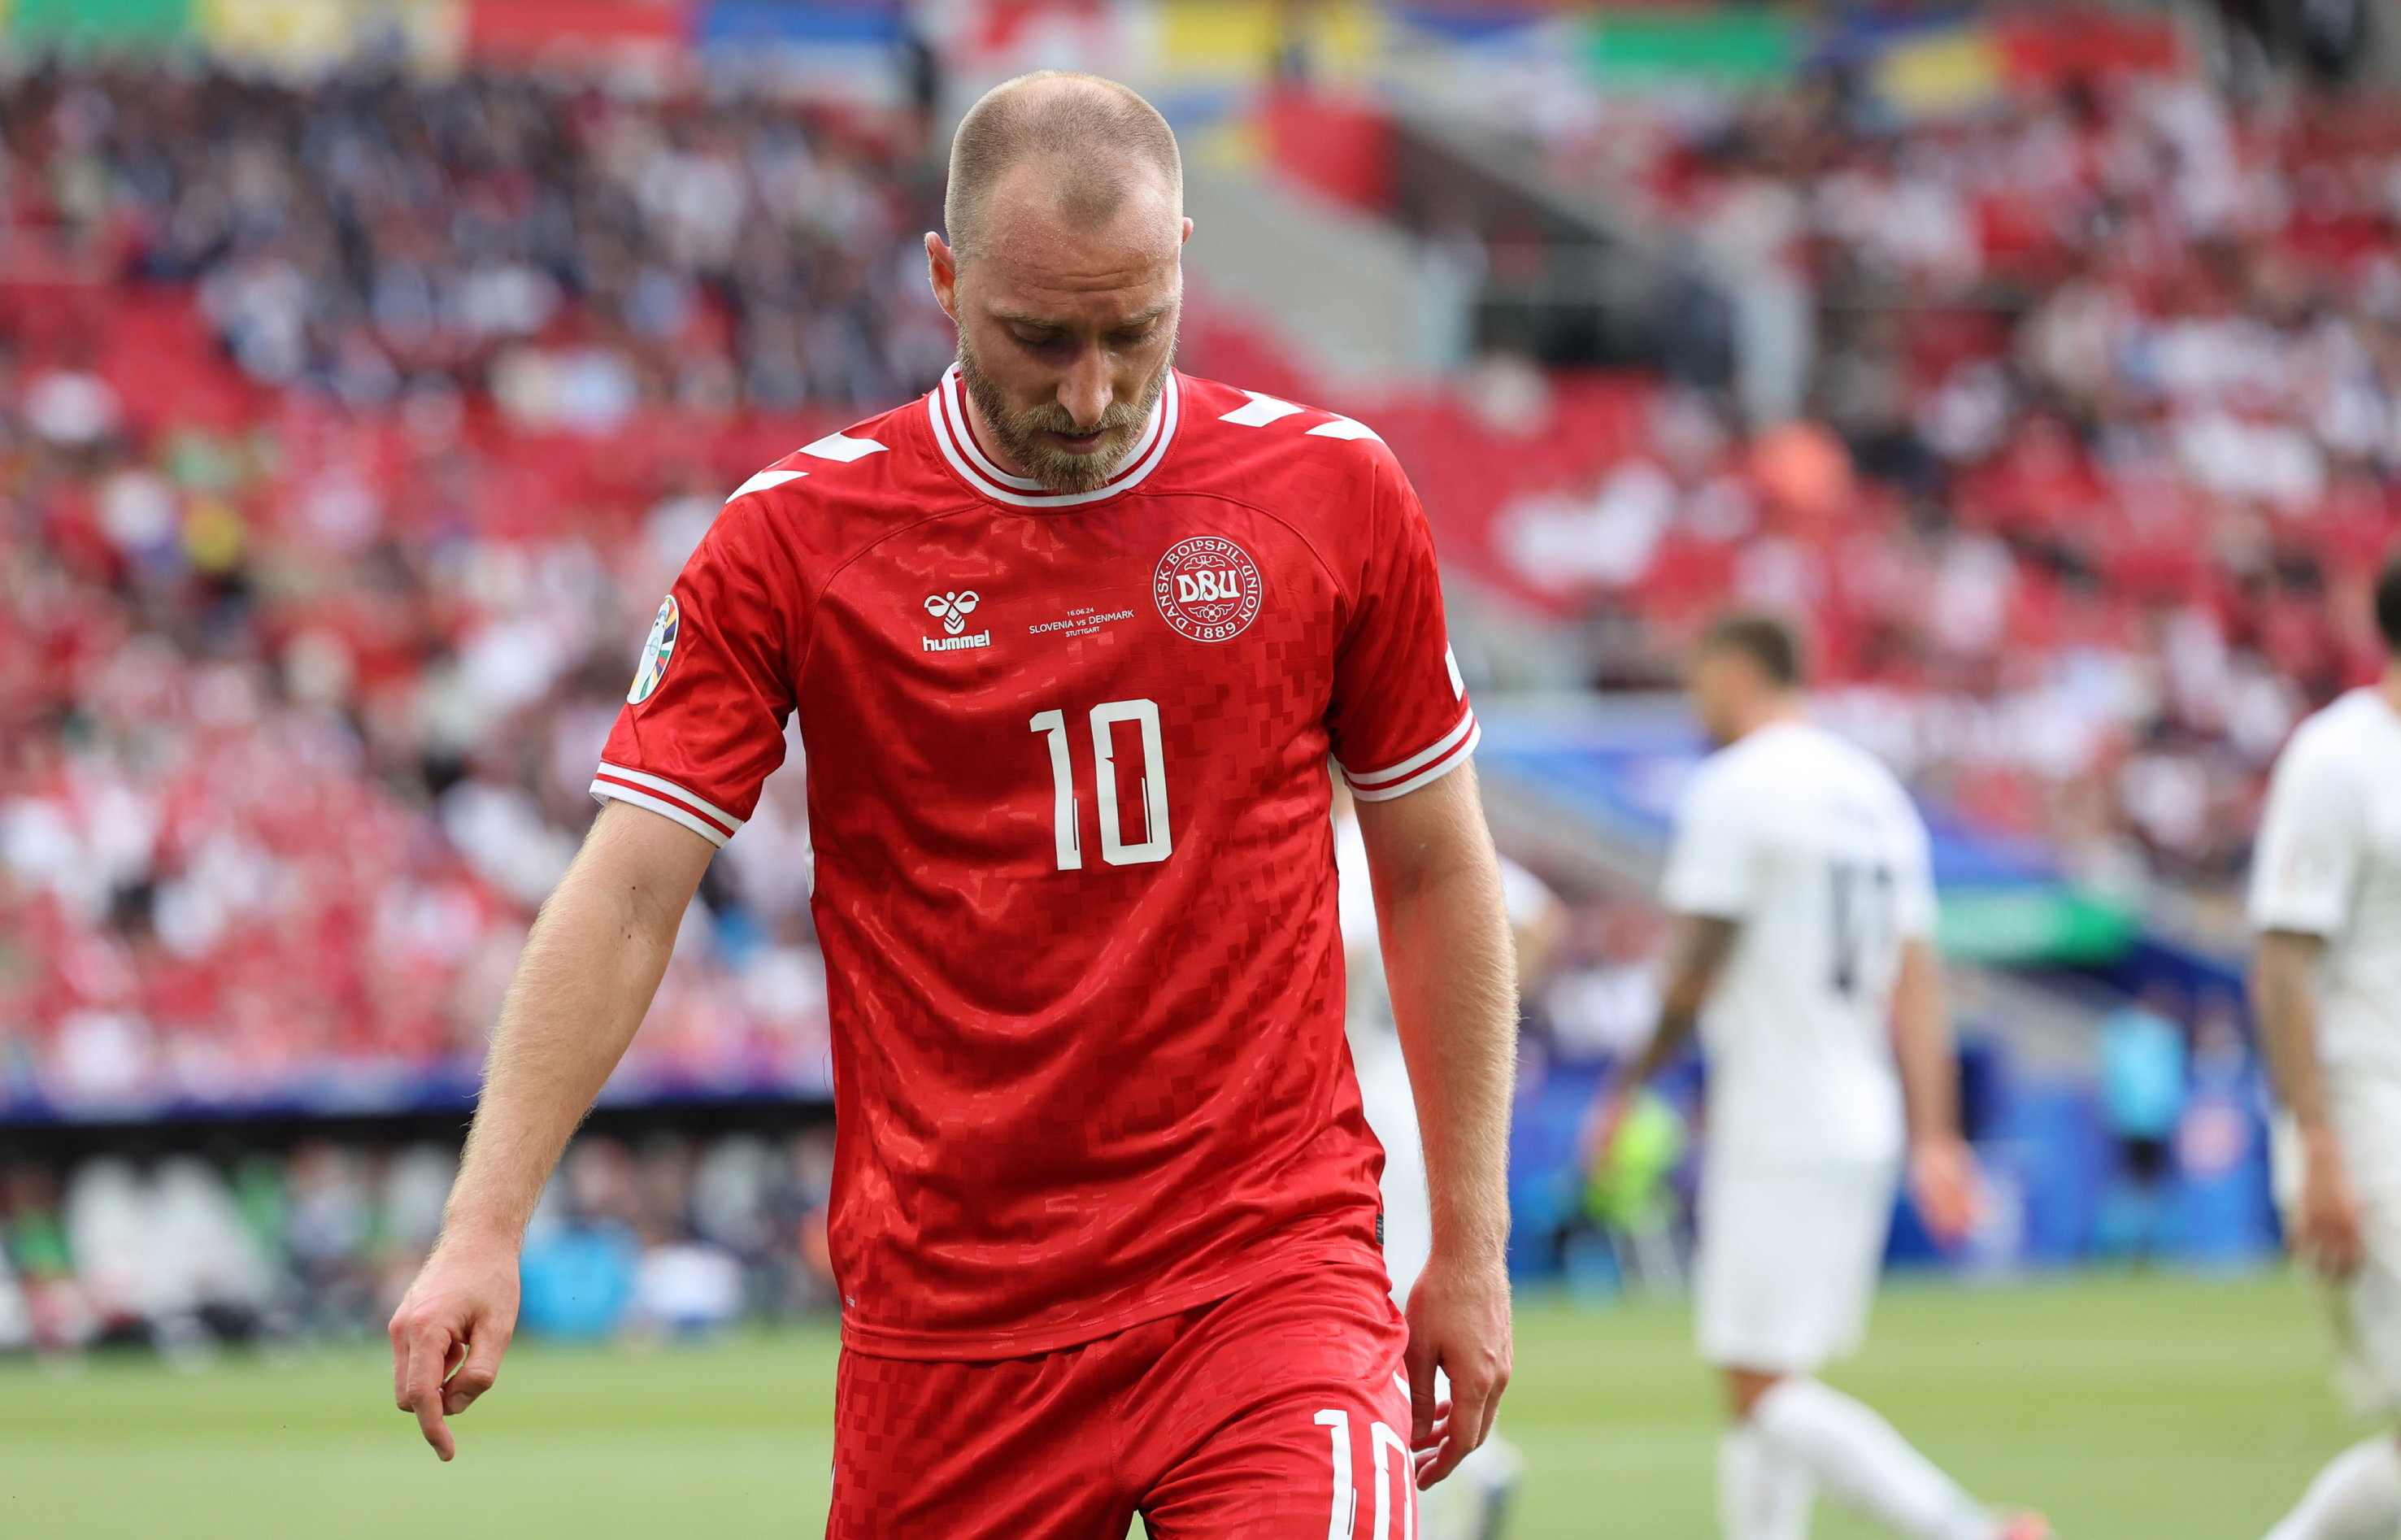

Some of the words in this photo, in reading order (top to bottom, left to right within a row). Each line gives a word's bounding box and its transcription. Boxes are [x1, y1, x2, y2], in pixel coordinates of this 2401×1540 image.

[1176, 570, 1241, 603] DBU
[1067, 607, 1094, 616] 16.06.24
[1158, 569, 1189, 629] DANSK
[1194, 622, 1236, 638] 1889
[1029, 620, 1074, 633] SLOVENIA
[1088, 610, 1134, 624] DENMARK
[1065, 626, 1100, 637] STUTTGART
[922, 629, 990, 651] hummel
[1029, 698, 1172, 871] 10
[1313, 1409, 1413, 1540] 10
